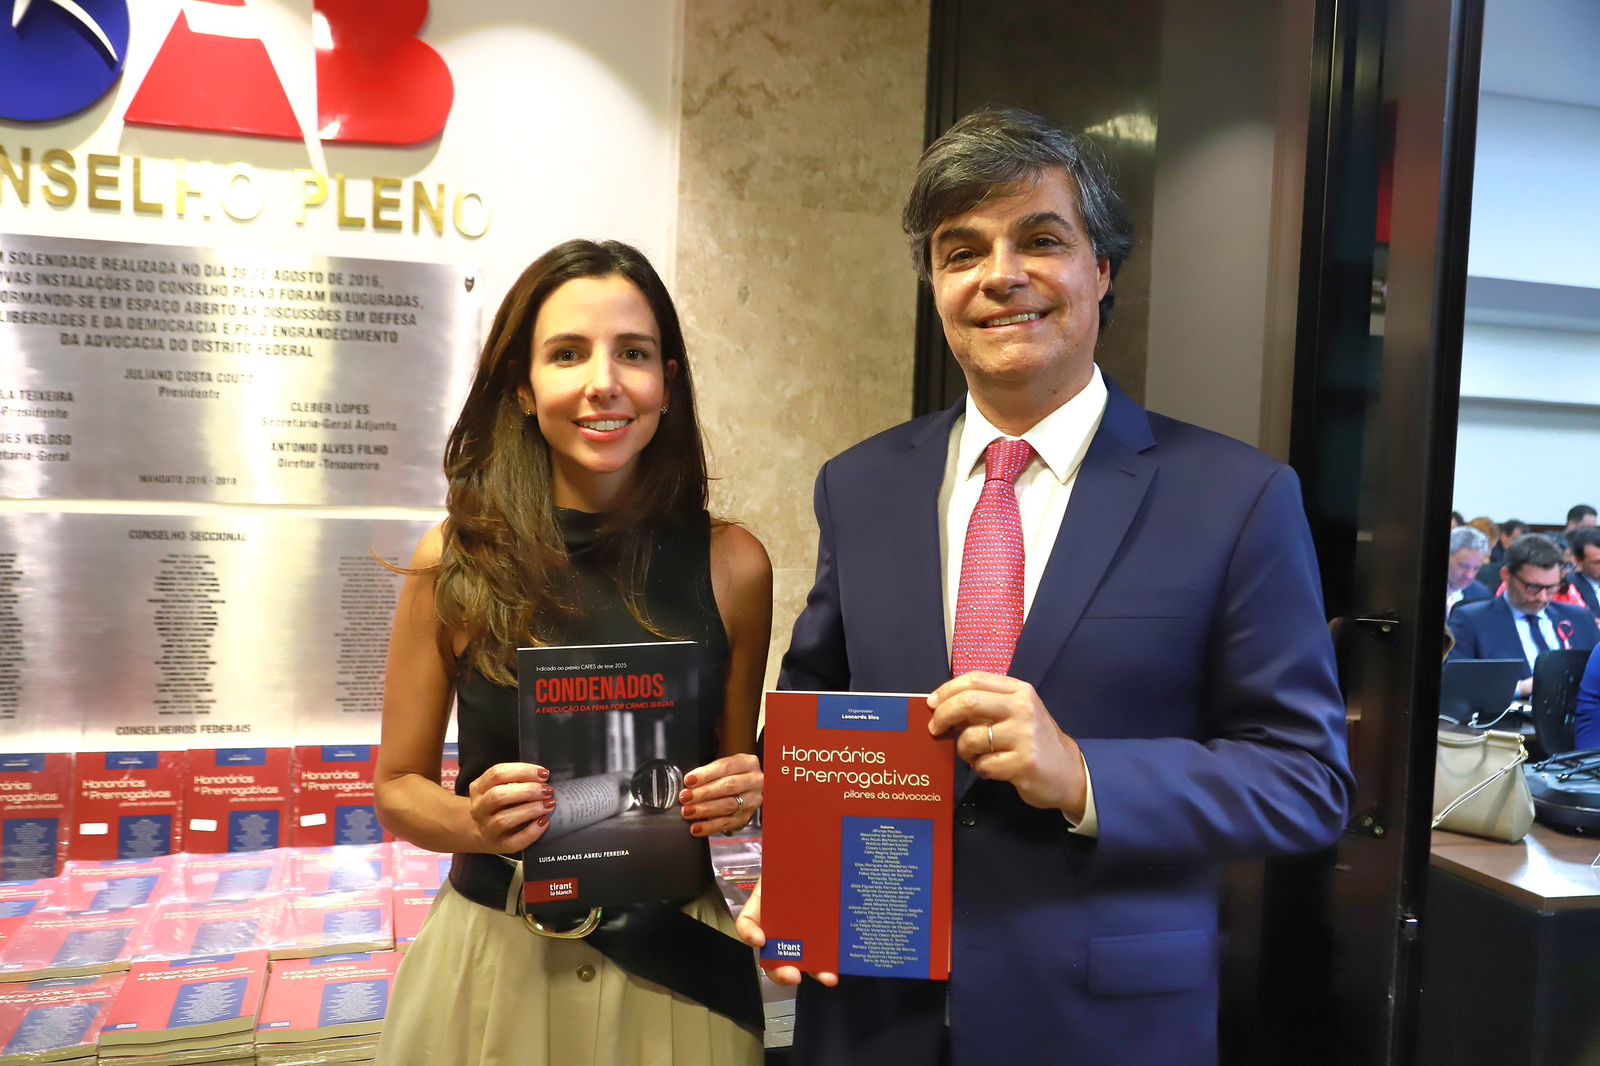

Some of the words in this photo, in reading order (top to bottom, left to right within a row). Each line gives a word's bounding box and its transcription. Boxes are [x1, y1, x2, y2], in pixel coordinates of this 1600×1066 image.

[295, 168, 490, 238] PLENO
[9, 252, 97, 270] SOLENIDADE
[102, 257, 176, 274] REALIZADA
[181, 262, 200, 276] NO
[204, 264, 226, 277] DIA
[274, 269, 323, 284] AGOSTO
[328, 272, 343, 285] DE
[36, 273, 132, 292] INSTALAÇÕES
[136, 278, 154, 293] DO
[159, 280, 228, 296] CONSELHO
[280, 288, 325, 302] FORAM
[101, 295, 122, 310] EM
[127, 297, 180, 315] ESPAÇO
[184, 301, 236, 316] ABERTO
[346, 310, 364, 323] EM
[370, 311, 417, 326] DEFESA
[90, 315, 99, 328] E
[104, 316, 123, 330] DA
[127, 316, 217, 333] DEMOCRACIA
[222, 322, 229, 334] E
[272, 325, 399, 343] ENGRANDECIMENTO
[60, 333, 80, 346] DA
[84, 334, 164, 350] ADVOCACIA
[170, 339, 187, 352] DO
[192, 339, 251, 354] DISTRITO
[258, 343, 313, 357] FEDERAL
[124, 368, 173, 382] JULIANO
[176, 370, 212, 383] COSTA
[19, 390, 75, 402] TEIXEIRA
[158, 386, 220, 400] Presidente
[335, 403, 370, 415] LOPES
[320, 442, 354, 455] ALVES
[357, 444, 389, 456] FILHO
[129, 530, 185, 541] CONSELHO
[189, 531, 246, 541] SECCIONAL
[535, 665, 557, 673] Indicado
[535, 673, 665, 704] CONDENADOS
[542, 704, 580, 714] EXECUÇÃO
[115, 725, 196, 736] CONSELHEIROS
[200, 724, 251, 734] FEDERAIS
[782, 745, 886, 764] Honorários
[193, 774, 256, 785] Honorários
[301, 770, 360, 780] Honorários
[781, 766, 790, 775] e
[794, 766, 930, 789] Prerrogativas
[82, 778, 147, 789] Honorários
[89, 789, 172, 802] Prerrogativas
[200, 785, 280, 797] Prerrogativas
[843, 789, 876, 800] pilares
[877, 790, 890, 800] da
[891, 791, 942, 802] advocacia
[556, 854, 582, 862] MORAES
[583, 851, 602, 860] ABREU
[603, 849, 630, 858] FERREIRA
[549, 882, 572, 891] tirant
[777, 942, 800, 951] tirant
